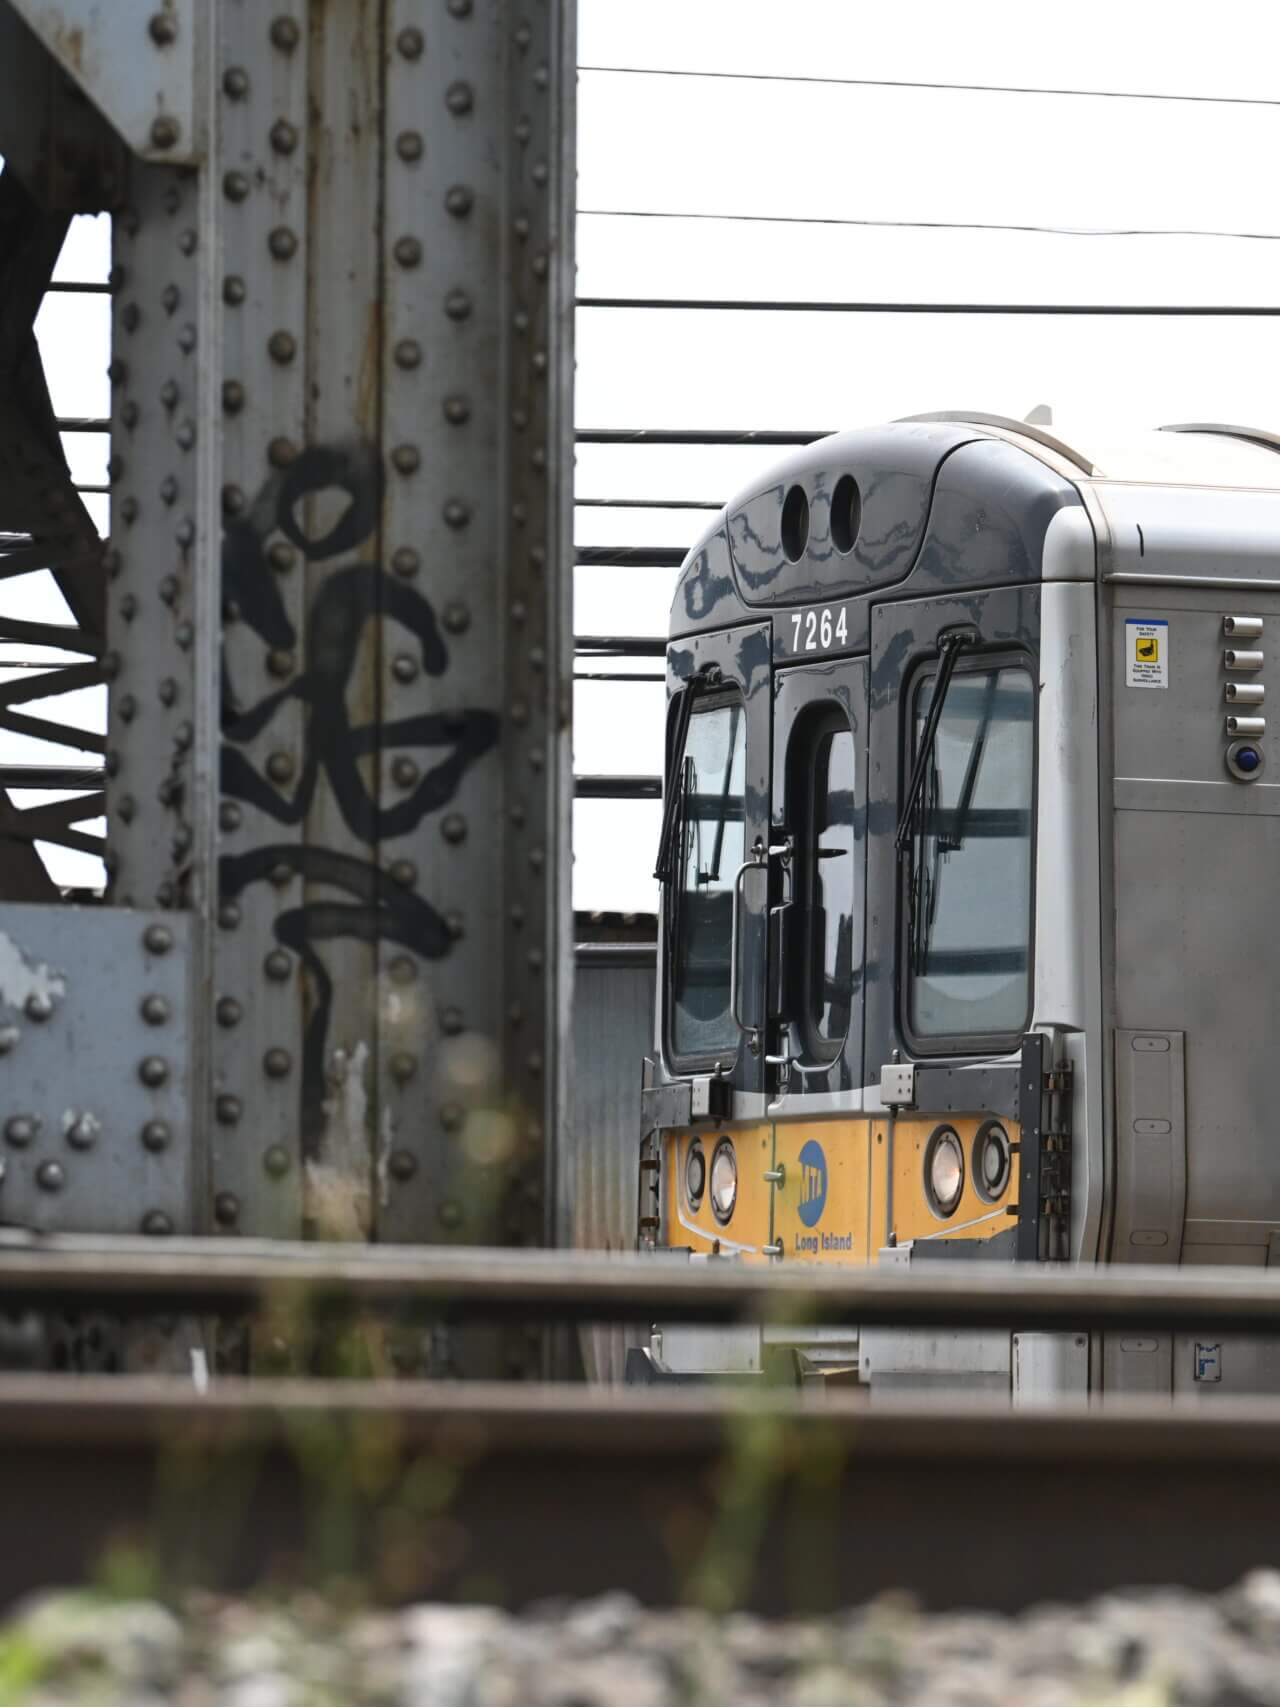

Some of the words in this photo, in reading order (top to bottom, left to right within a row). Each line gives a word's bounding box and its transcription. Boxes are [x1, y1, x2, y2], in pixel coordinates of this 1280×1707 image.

[791, 606, 848, 652] 7264
[795, 1232, 819, 1254] Long
[821, 1232, 852, 1251] Island
